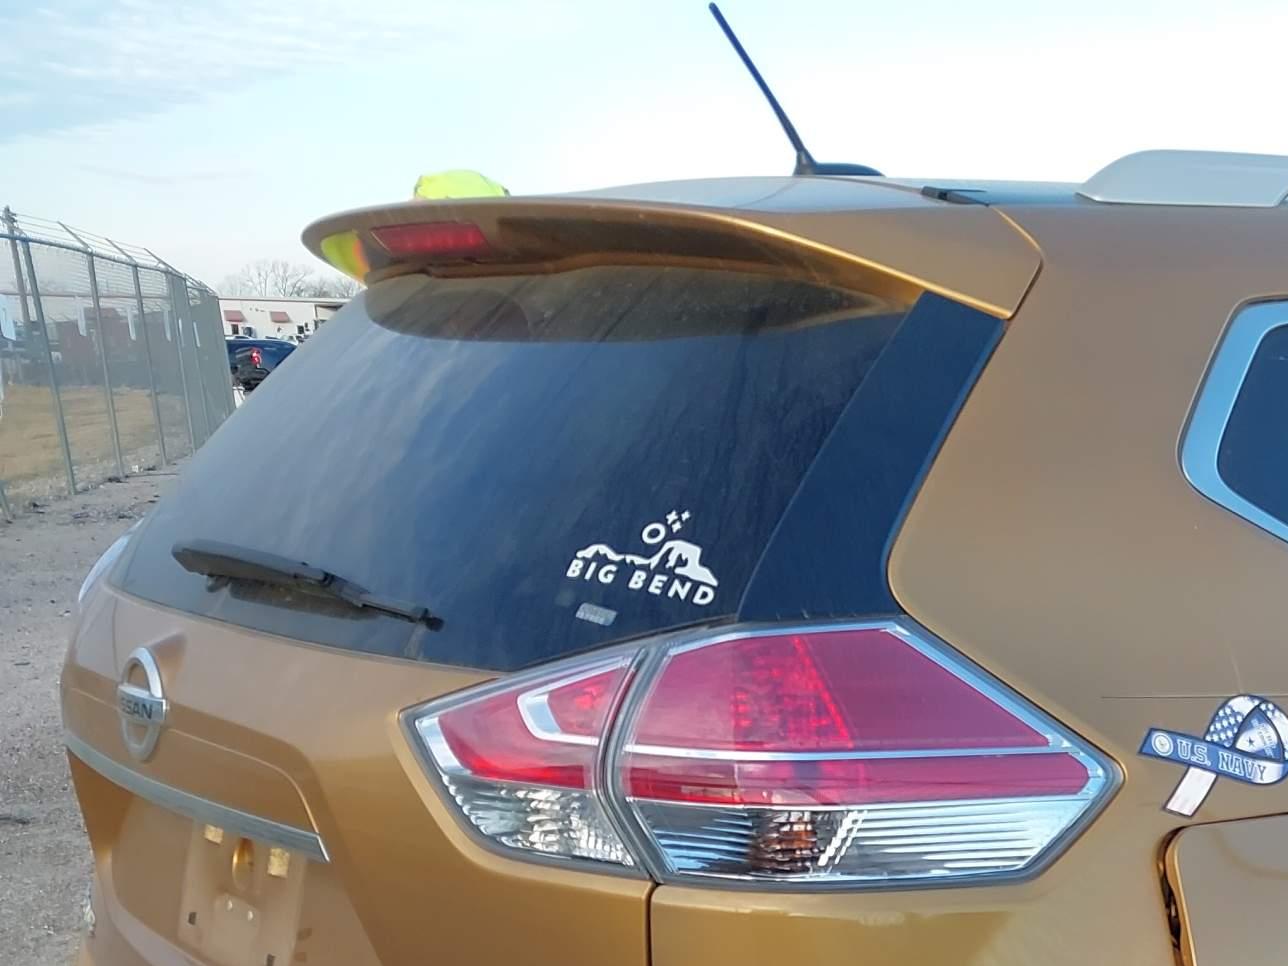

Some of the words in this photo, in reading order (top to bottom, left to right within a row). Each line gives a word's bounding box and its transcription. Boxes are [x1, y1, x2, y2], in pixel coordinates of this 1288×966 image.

[566, 558, 618, 584] BIG
[628, 569, 715, 606] BEND
[1177, 738, 1212, 767] U.S.
[1218, 751, 1267, 781] NAVY
